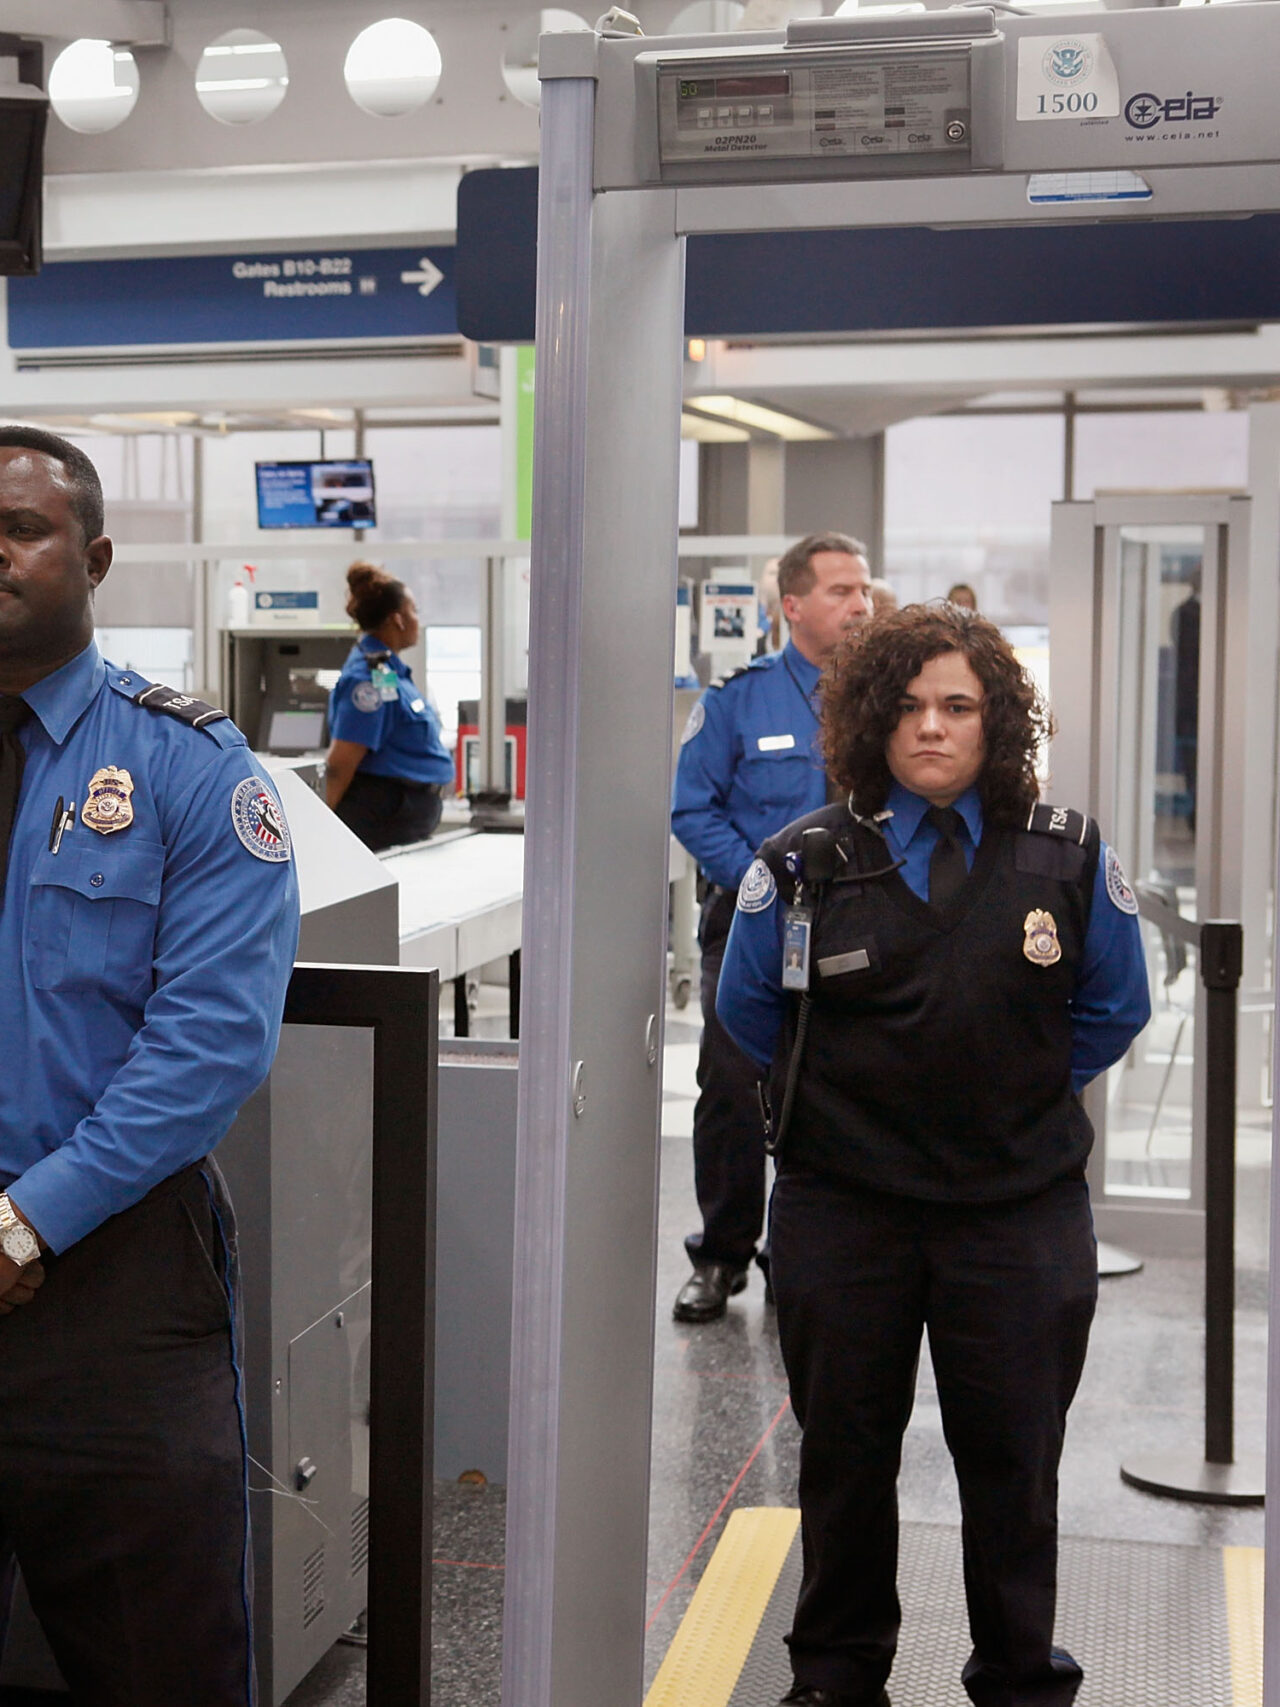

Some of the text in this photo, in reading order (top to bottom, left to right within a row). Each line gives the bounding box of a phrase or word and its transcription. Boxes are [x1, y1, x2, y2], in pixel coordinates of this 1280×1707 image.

[1036, 92, 1098, 114] 1500
[714, 134, 757, 146] 02PN20
[1124, 130, 1220, 142] www.ceia.net
[704, 143, 768, 153] Metal Detector
[232, 257, 352, 279] Gates B10-B22
[263, 280, 352, 298] Restrooms
[162, 694, 200, 710] TSA
[1048, 807, 1068, 831] TSA
